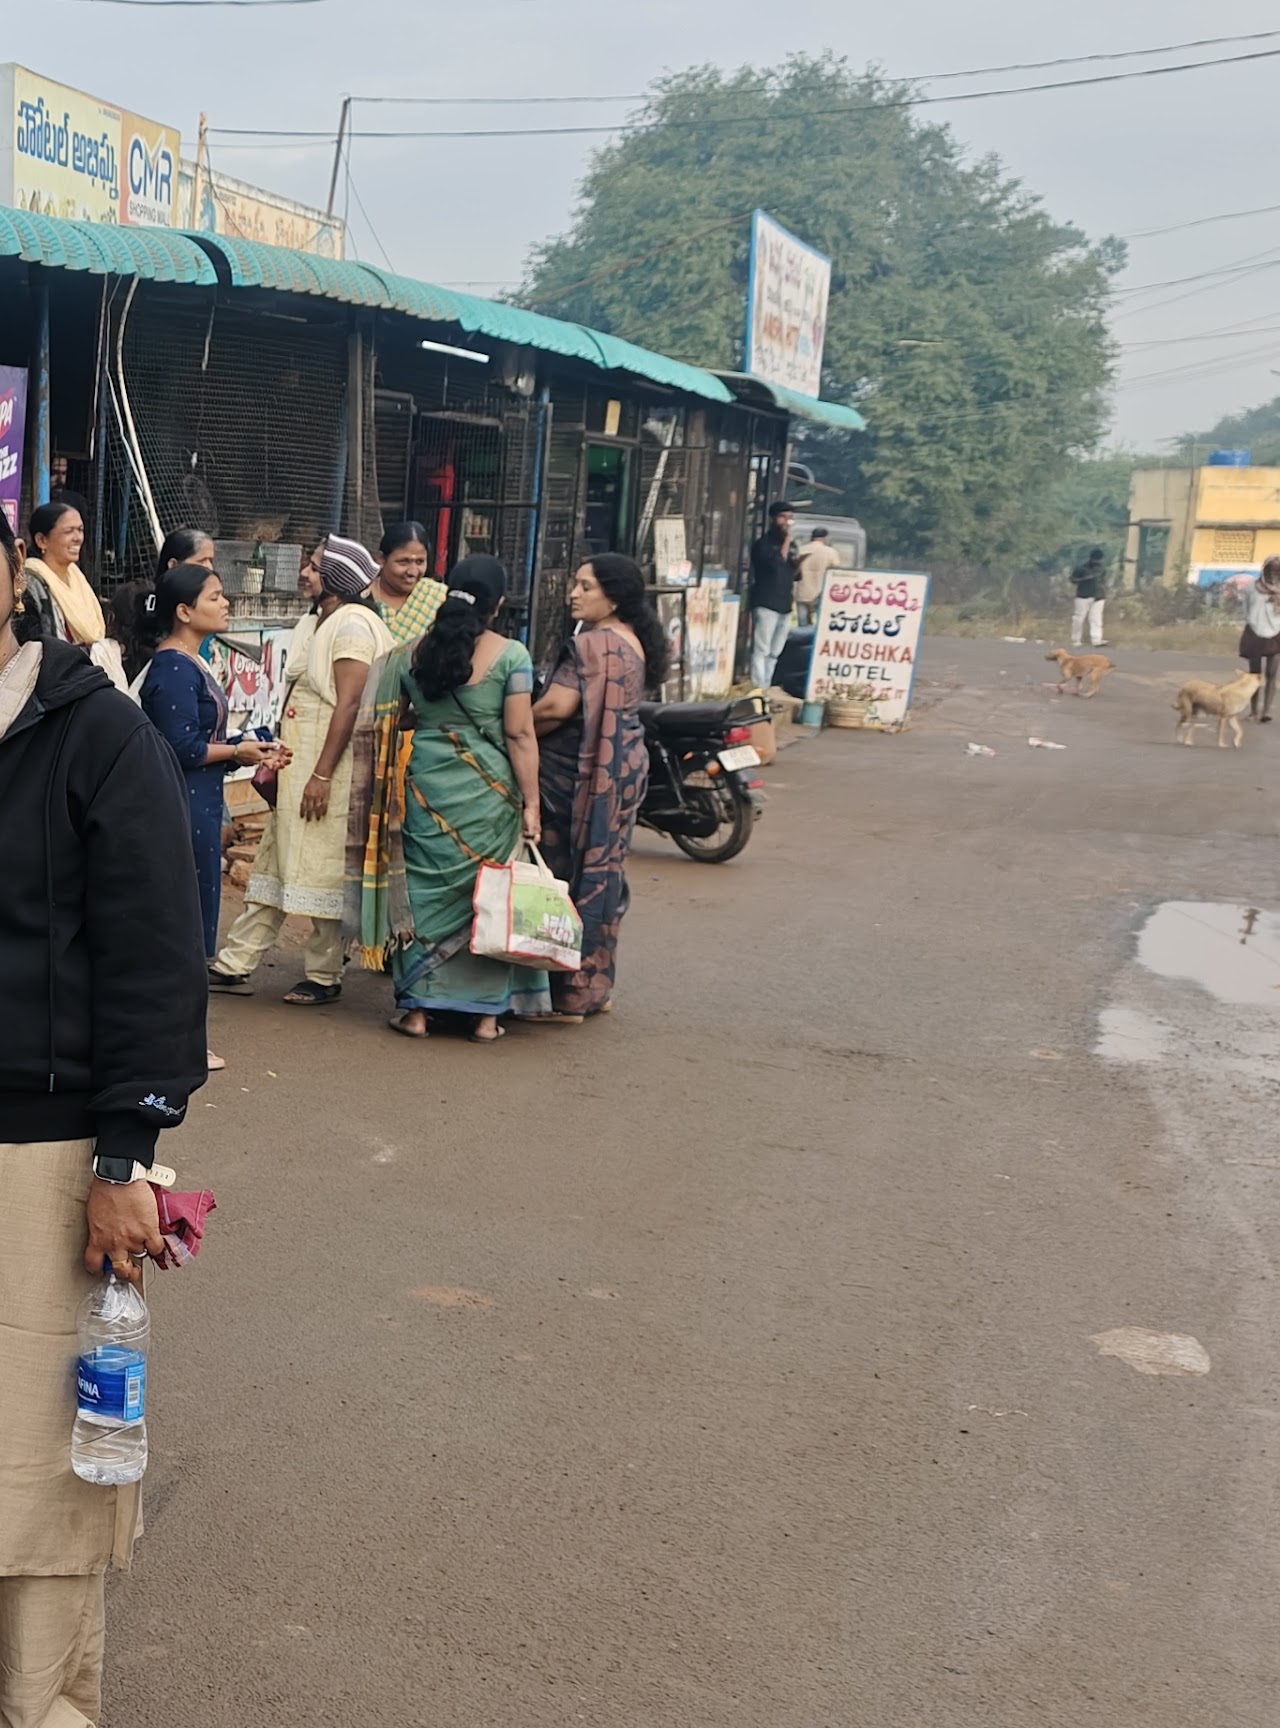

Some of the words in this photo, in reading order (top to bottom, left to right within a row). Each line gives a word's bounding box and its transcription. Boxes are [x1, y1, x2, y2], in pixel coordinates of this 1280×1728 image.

[130, 132, 171, 206] CMR
[819, 640, 914, 665] ANUSHKA
[827, 662, 892, 682] HOTEL
